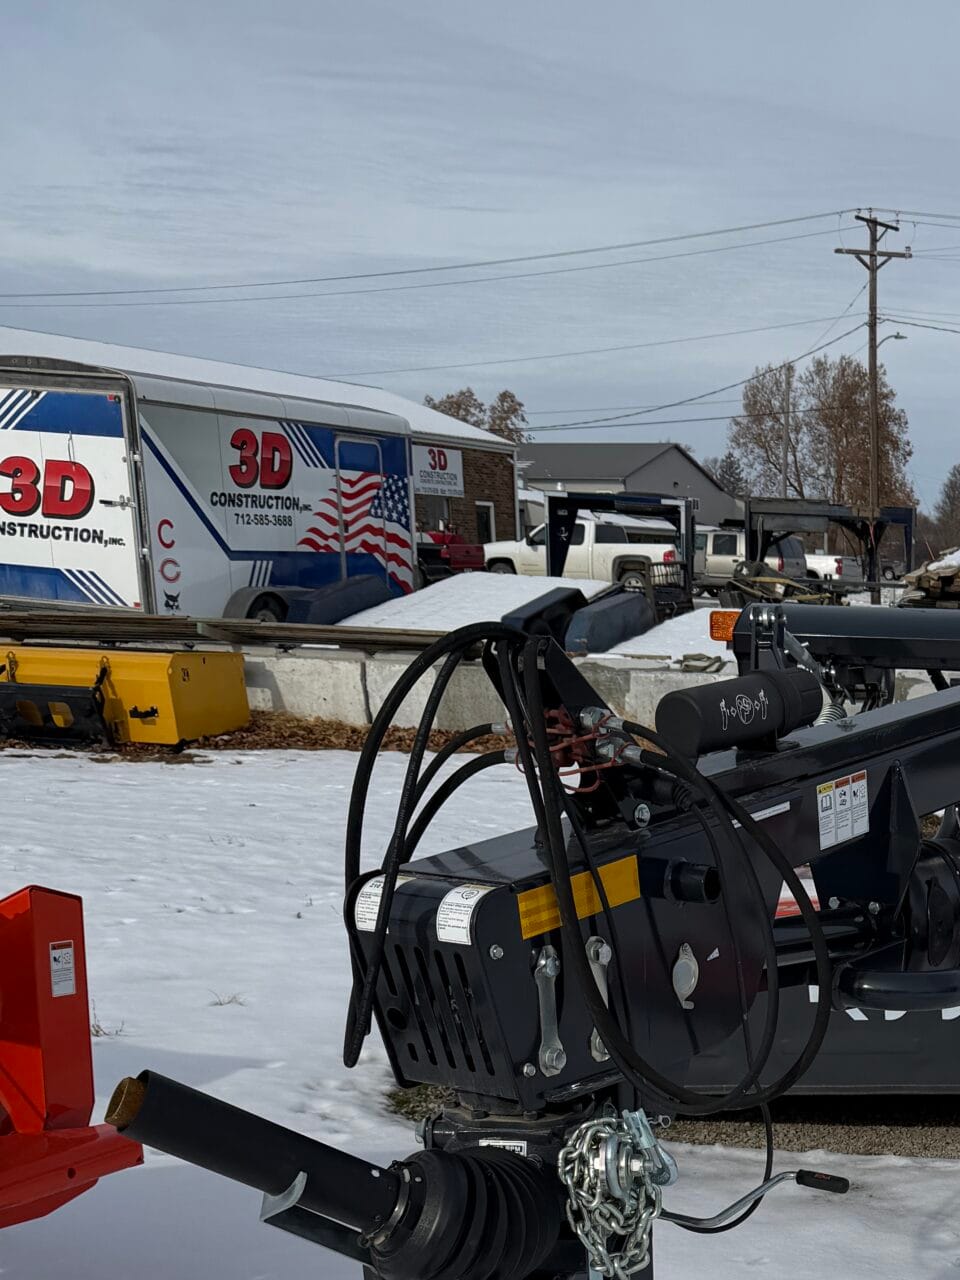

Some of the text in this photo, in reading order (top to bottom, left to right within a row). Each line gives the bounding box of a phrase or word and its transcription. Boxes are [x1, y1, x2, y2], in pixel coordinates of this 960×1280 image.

[229, 428, 293, 490] 3D
[427, 447, 448, 471] 3D
[0, 456, 95, 520] 3D
[234, 513, 293, 527] 712-585-3688
